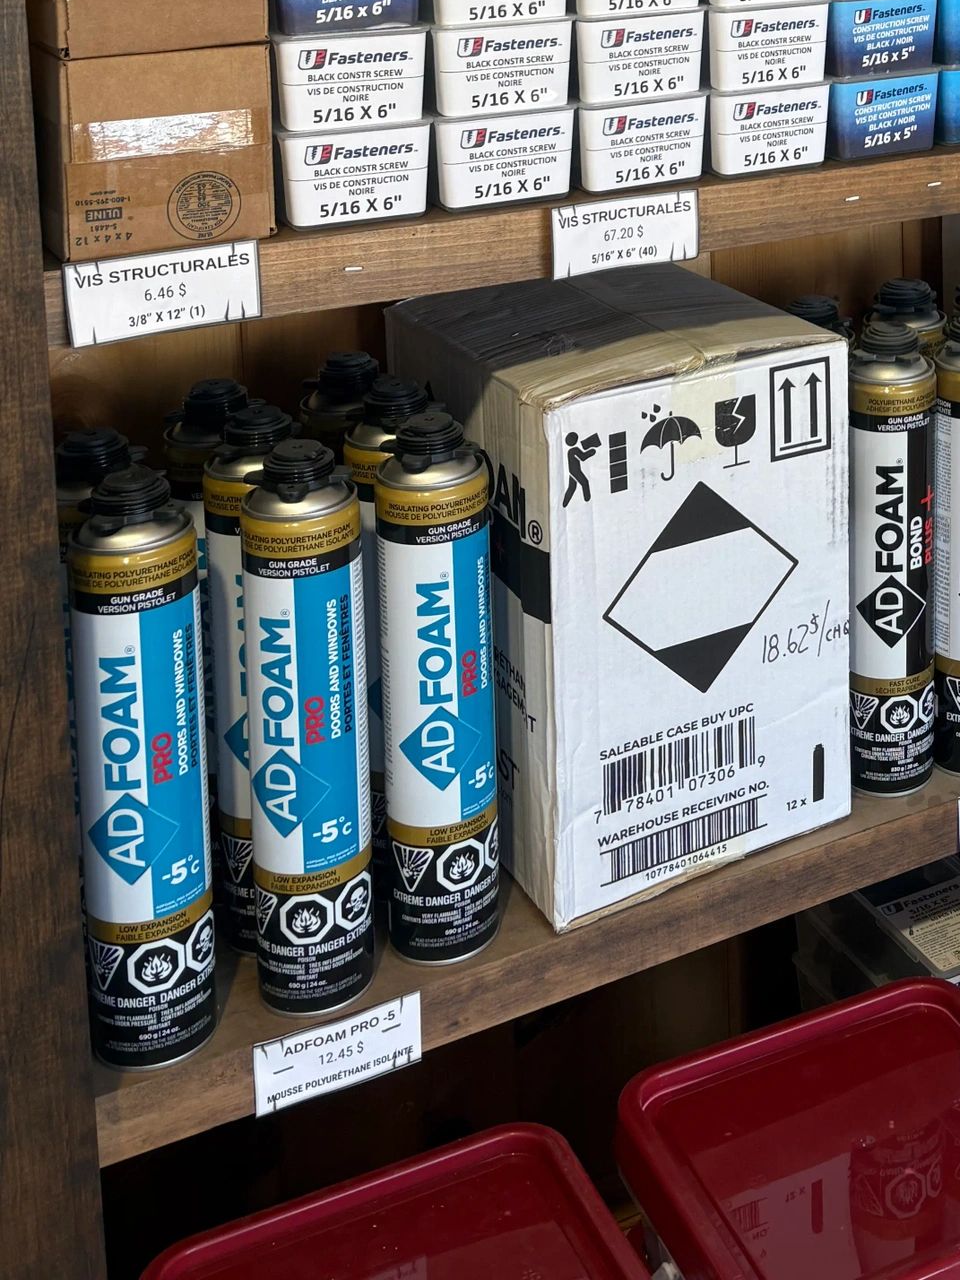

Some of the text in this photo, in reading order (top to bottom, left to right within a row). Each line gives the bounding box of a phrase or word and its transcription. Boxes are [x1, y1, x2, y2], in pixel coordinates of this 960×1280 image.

[875, 84, 924, 100] Fasteners
[864, 125, 917, 148] 5/16 x 5"
[334, 143, 414, 160] Fasteners
[314, 161, 408, 177] BLACK CONSTR SCREW
[314, 182, 327, 191] VIS
[343, 174, 409, 188] CONSTRUCTION
[349, 187, 375, 196] NOIRE
[87, 209, 121, 220] ULINE
[320, 195, 402, 218] 5/16 X 6"
[558, 200, 691, 229] VIS STRUCTURALES
[604, 225, 644, 242] 67.20 $
[591, 244, 657, 264] 5/16" X 6" (40)
[75, 252, 250, 288] VIS STRUCTURALES
[144, 282, 187, 302] 6.46 $
[128, 304, 206, 327] 3/8" X 12" (1)
[875, 466, 904, 634] ADFOAM
[910, 516, 922, 570] BOND
[110, 588, 164, 605] GUN GRADE
[599, 703, 754, 761] SALEABLE CASE BUY UPC
[100, 656, 146, 867] ADFOAM
[152, 732, 172, 786] PRO
[594, 756, 765, 824] 7 78401 07306 9
[598, 781, 769, 847] WAREHOUSE RECEIVING NO.
[786, 798, 807, 812] 12 x
[283, 1010, 396, 1058] ADFOAM PRO -5
[318, 1041, 364, 1065] 12.45 $
[266, 1045, 414, 1104] MOUSSE POLYURÉTHANE ISOLANTE
